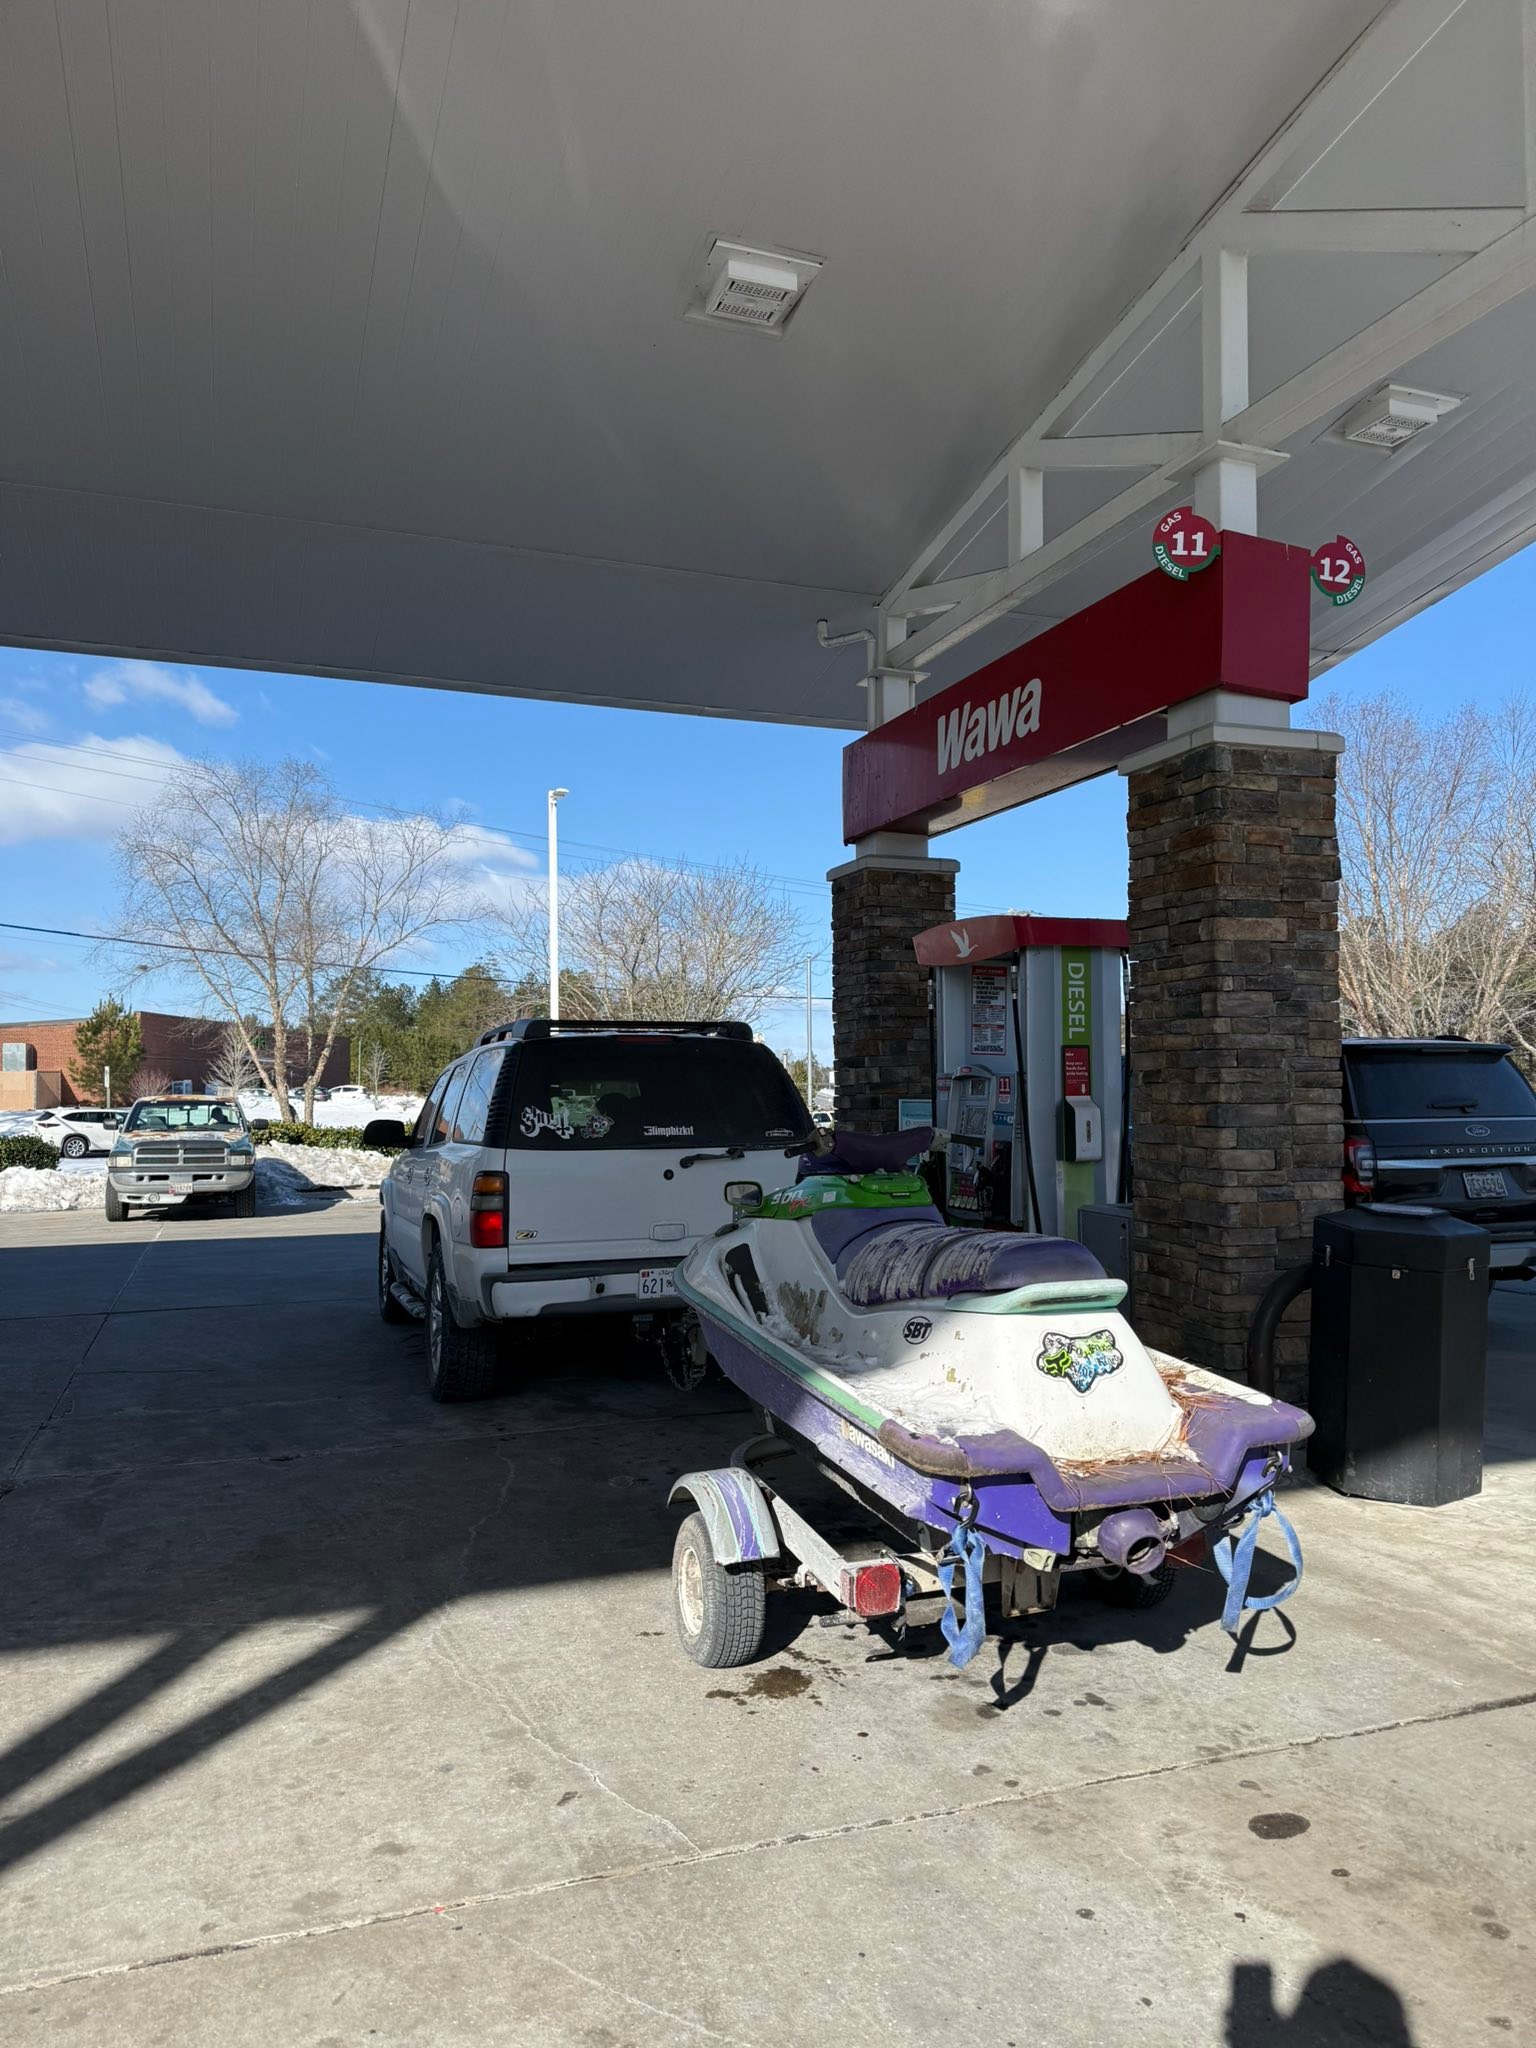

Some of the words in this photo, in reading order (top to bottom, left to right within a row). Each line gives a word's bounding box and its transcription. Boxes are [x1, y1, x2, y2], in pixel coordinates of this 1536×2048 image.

[1160, 512, 1182, 533] GAS
[1171, 531, 1208, 556] 11
[1345, 542, 1362, 565] GAS
[1155, 545, 1185, 579] DIESEL
[1319, 557, 1351, 585] 12
[1336, 577, 1364, 605] DIESEL
[937, 678, 1042, 776] Wawa
[1067, 962, 1086, 1040] DIESEL
[1000, 1078, 1010, 1092] 11
[1430, 1146, 1530, 1155] EXPEDITION
[643, 1278, 664, 1295] 621
[904, 1322, 932, 1339] SBT
